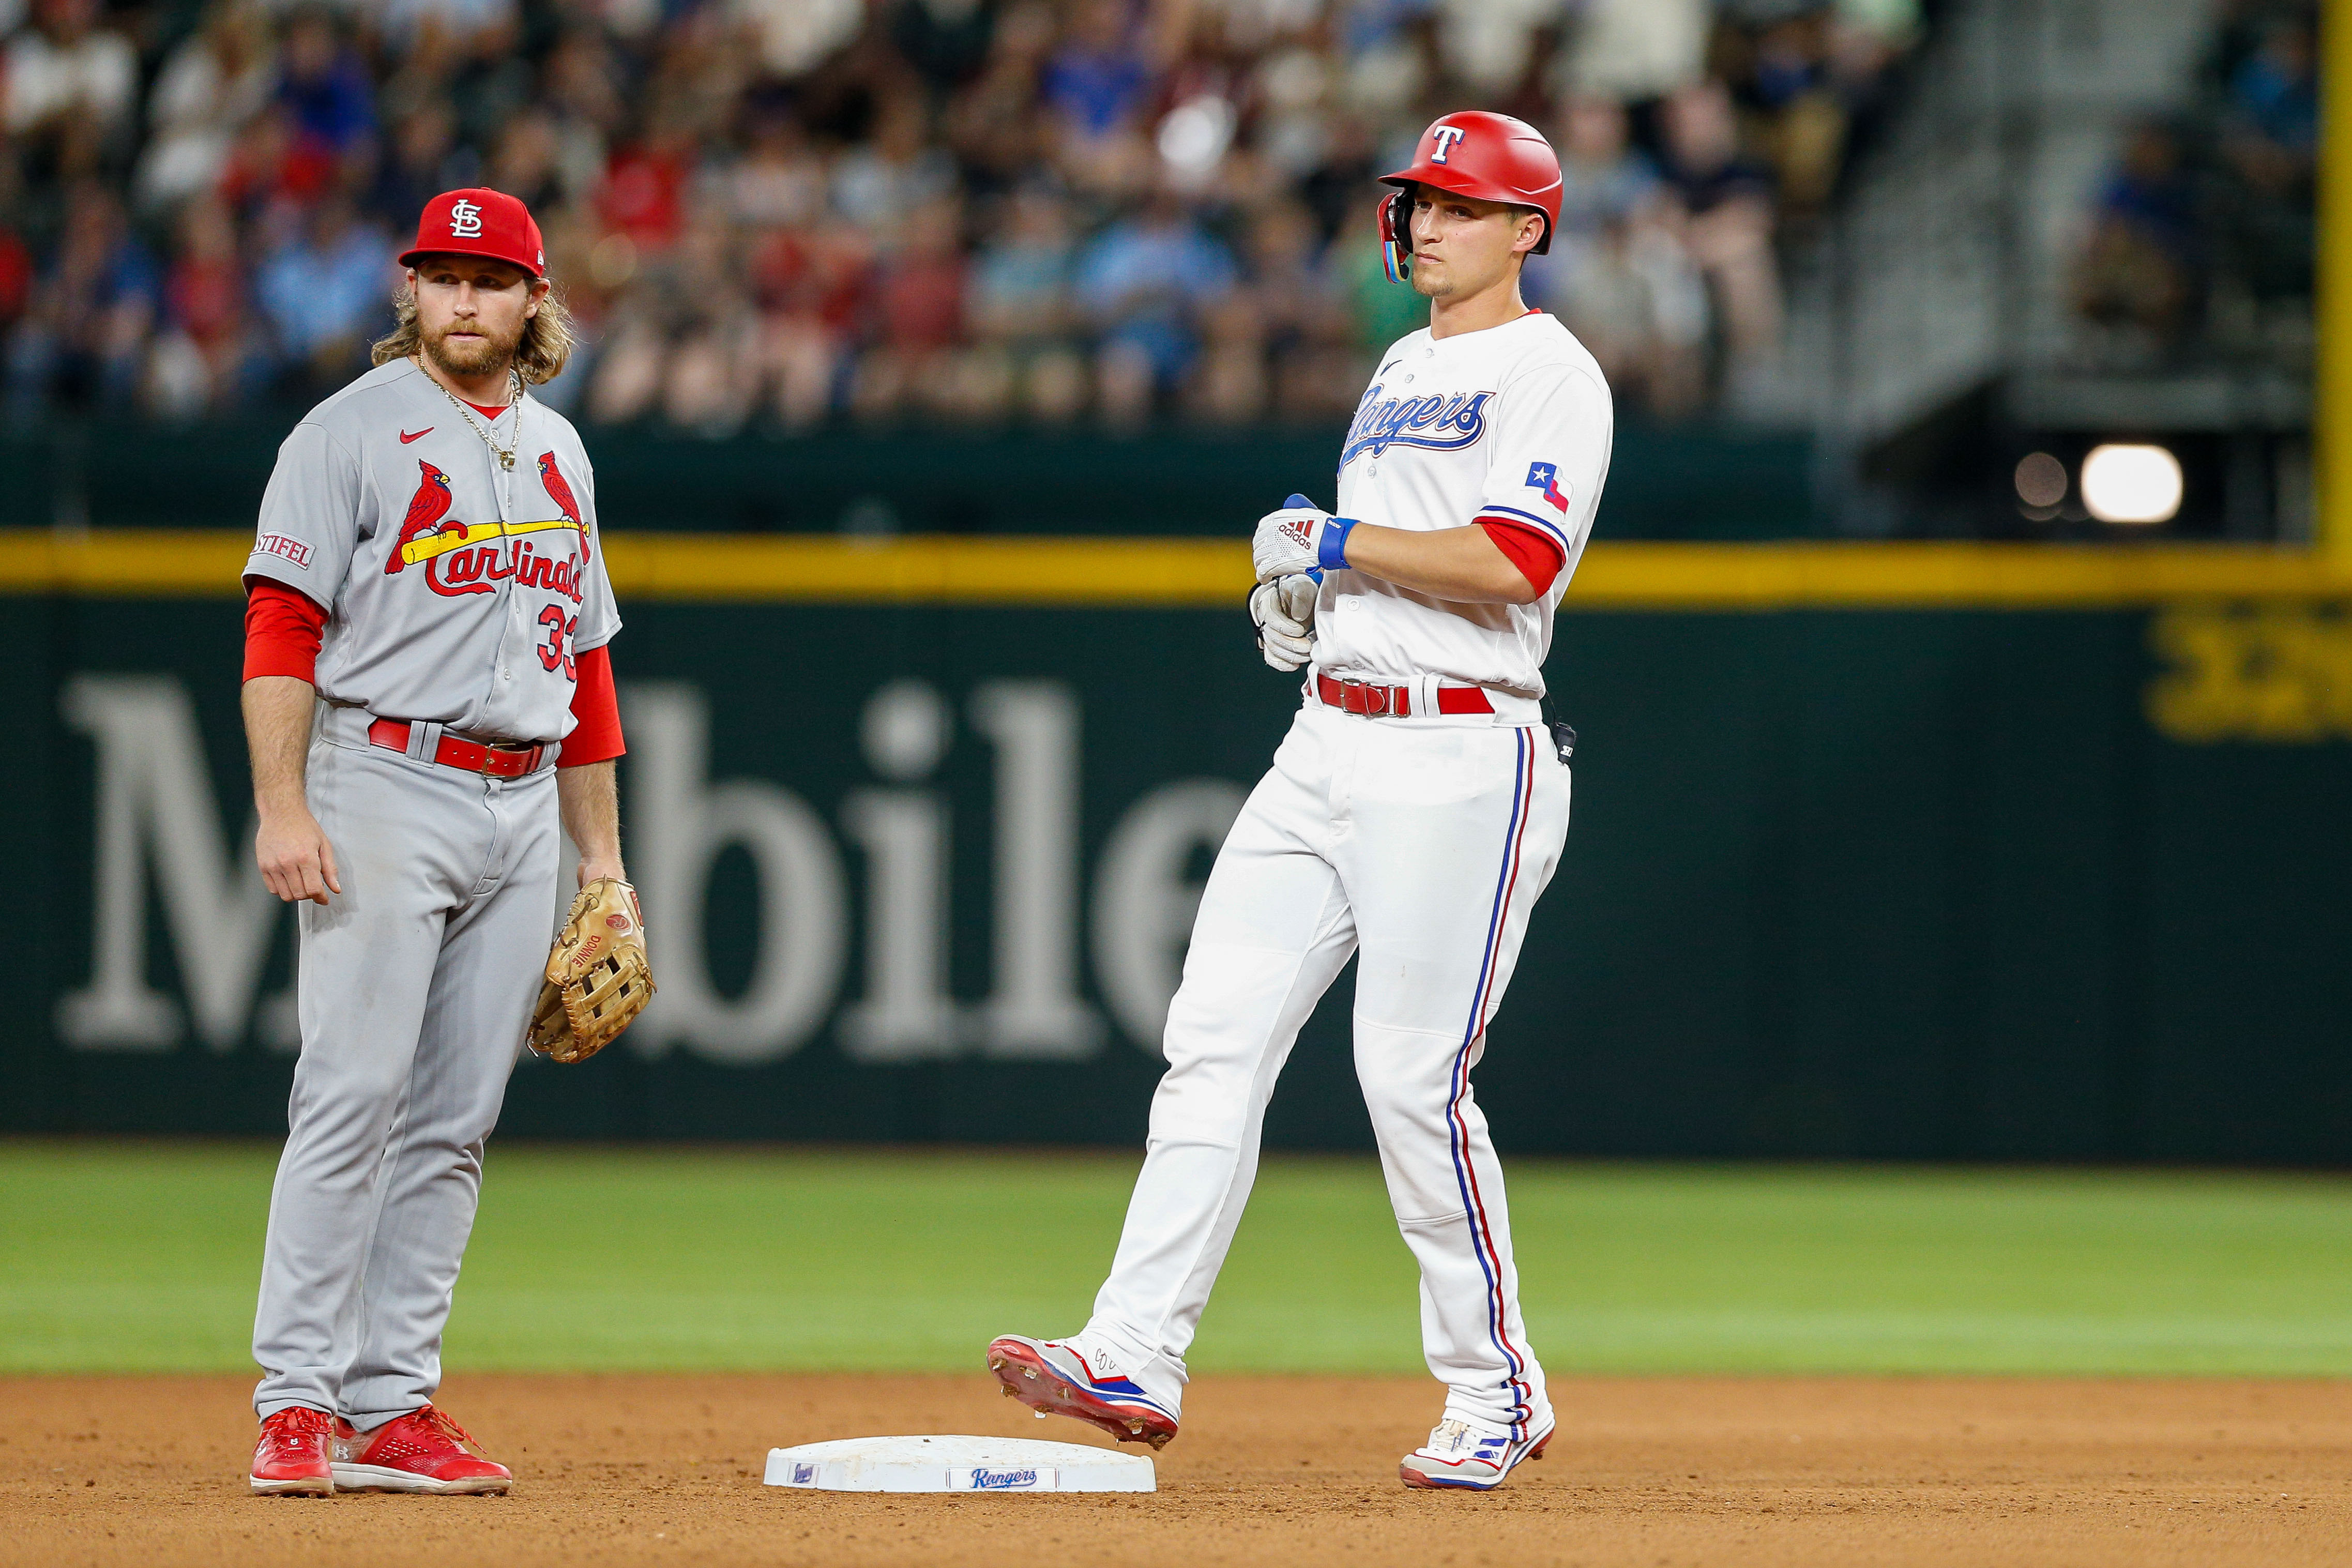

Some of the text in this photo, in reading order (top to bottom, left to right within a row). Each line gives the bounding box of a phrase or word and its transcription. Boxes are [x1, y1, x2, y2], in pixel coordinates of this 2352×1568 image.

[1431, 125, 1465, 164] T
[252, 534, 309, 567] STIFEL
[1279, 524, 1312, 550] adidas
[59, 675, 1247, 1066] Mbile
[571, 935, 602, 968] DONNIE
[970, 1468, 1037, 1489] Rangers
